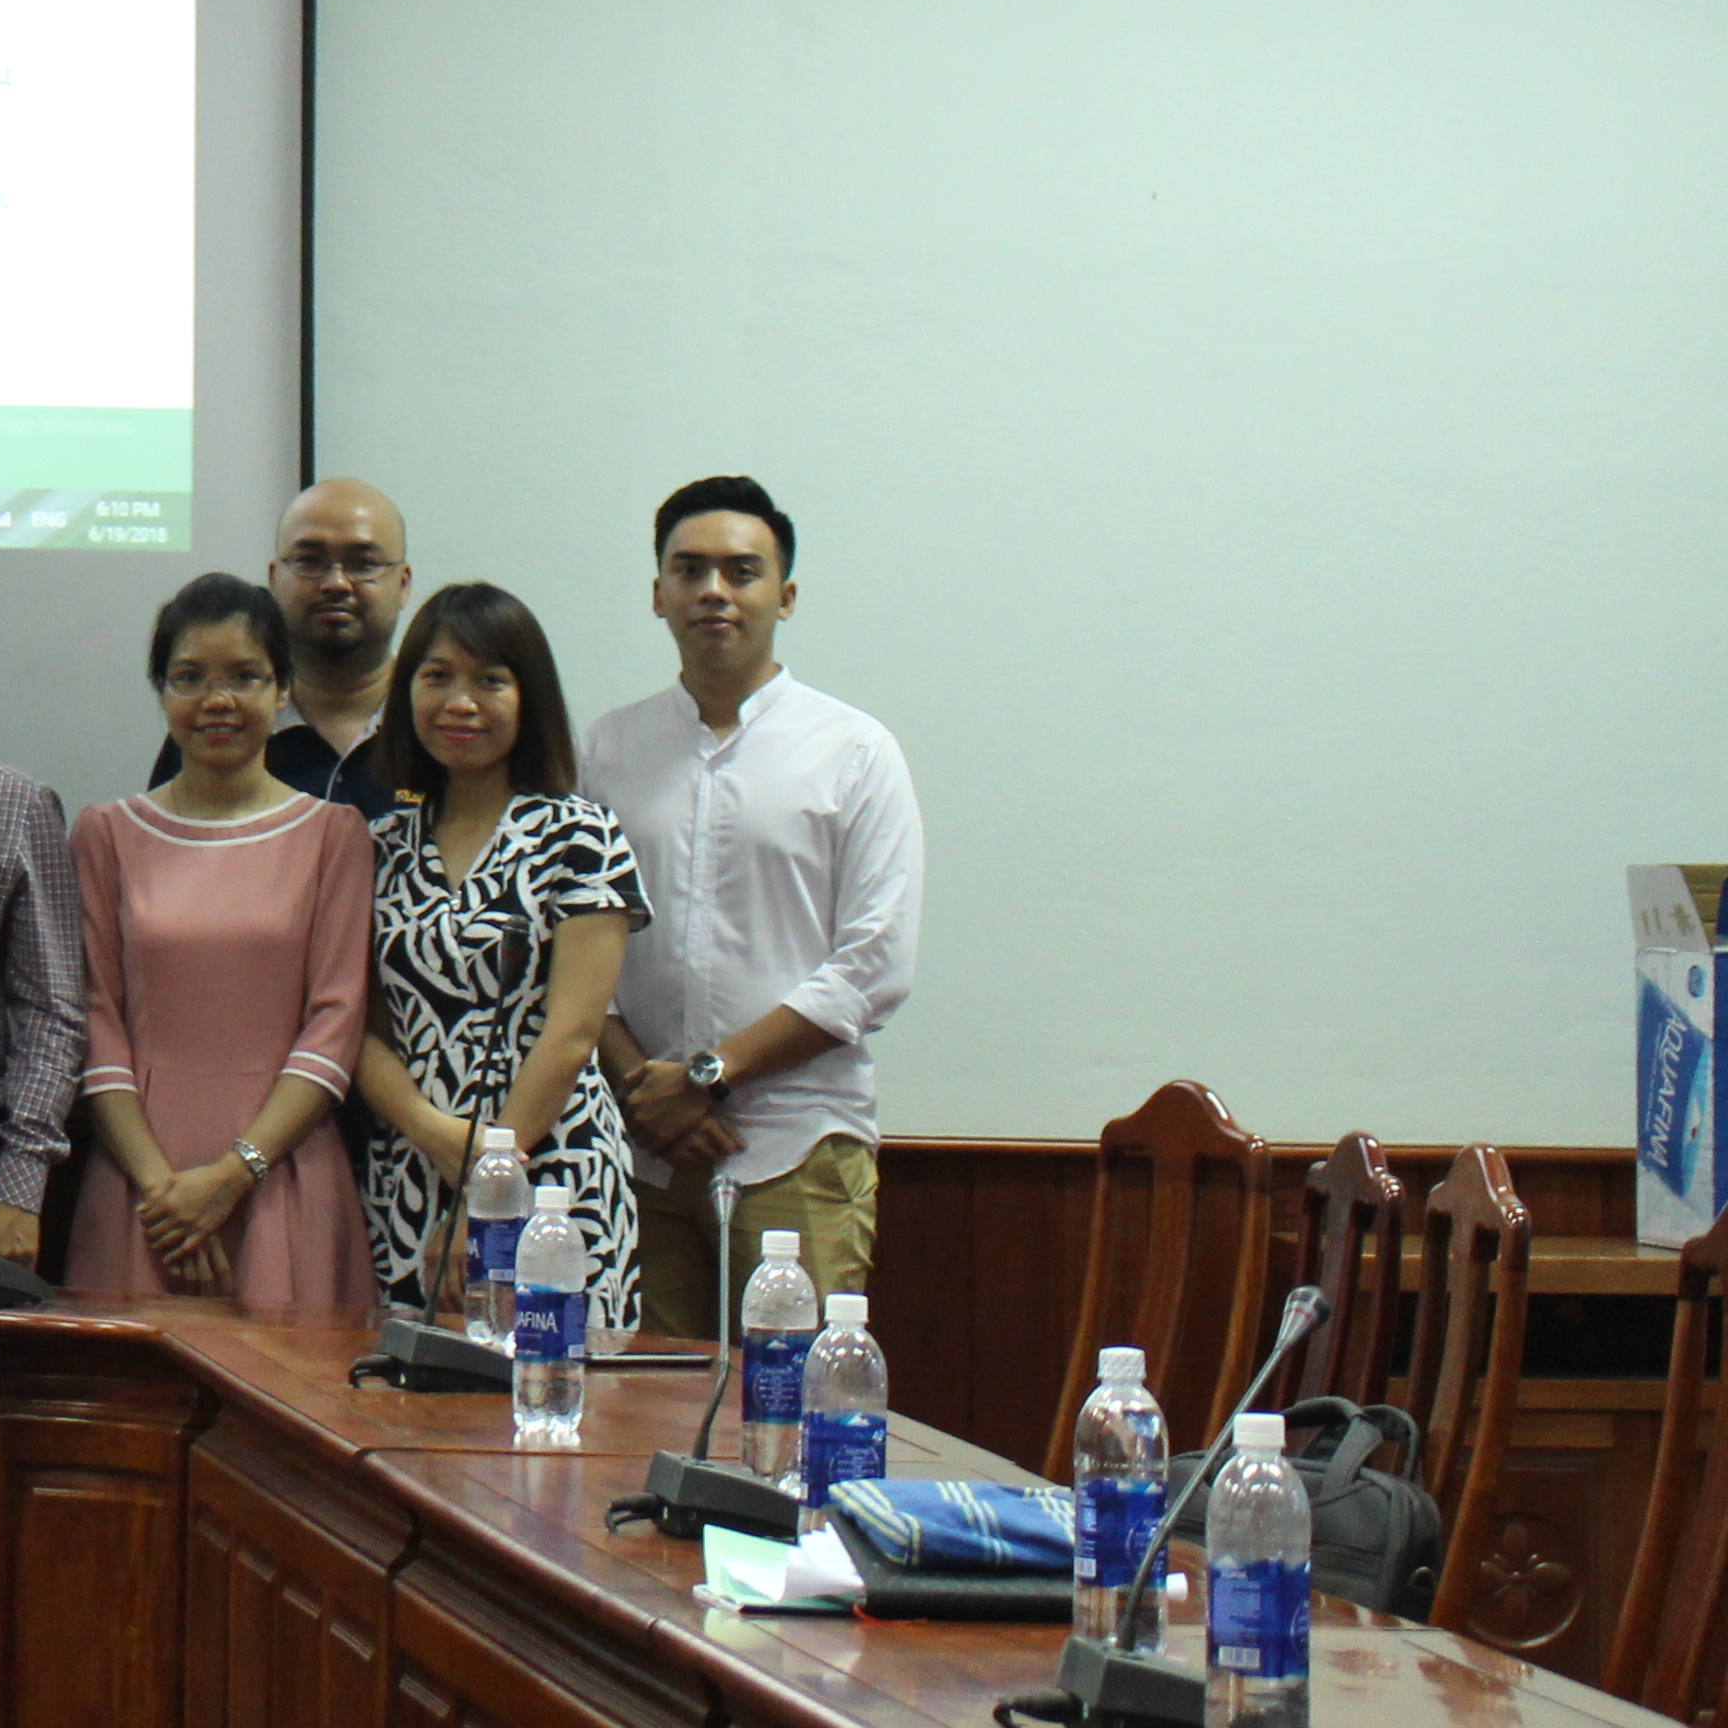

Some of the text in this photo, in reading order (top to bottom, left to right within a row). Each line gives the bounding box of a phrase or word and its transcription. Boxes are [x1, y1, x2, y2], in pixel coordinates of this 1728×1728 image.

[95, 499, 161, 518] 6:10 PM
[30, 510, 67, 528] ENG
[87, 525, 168, 544] 6/19/2018
[1647, 1003, 1689, 1169] AQUAFINA
[515, 1309, 559, 1335] AFINA
